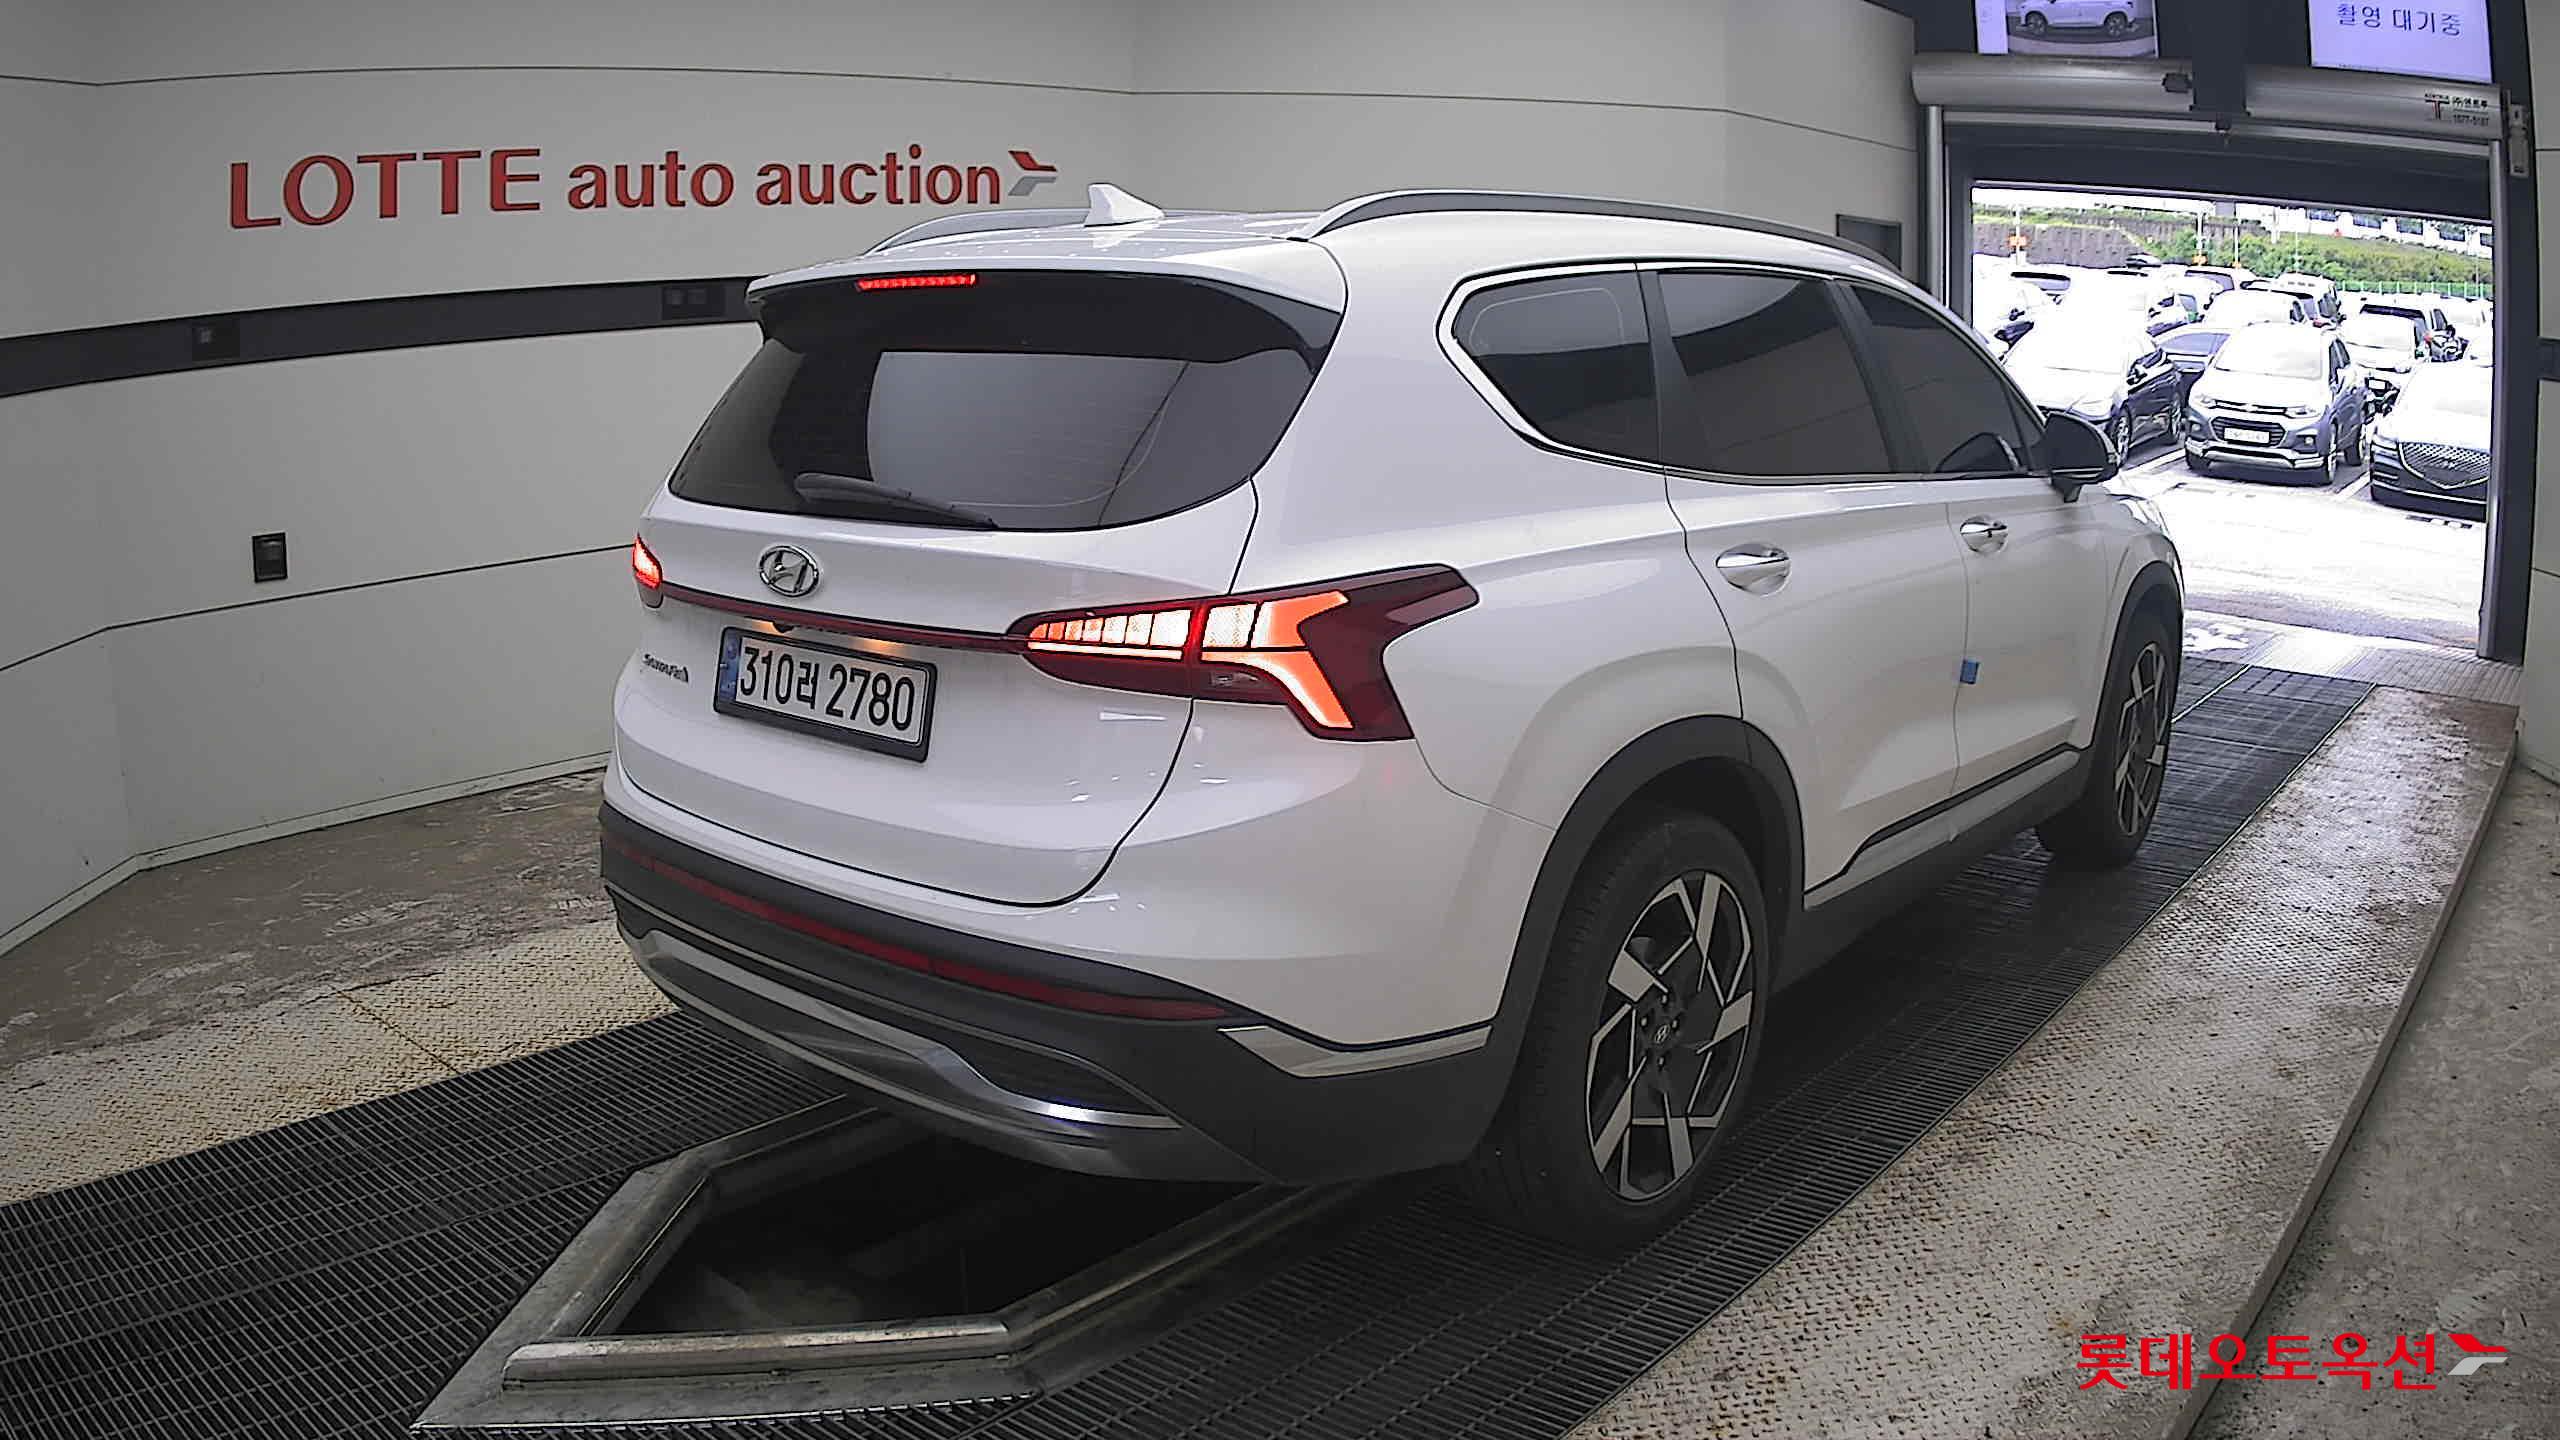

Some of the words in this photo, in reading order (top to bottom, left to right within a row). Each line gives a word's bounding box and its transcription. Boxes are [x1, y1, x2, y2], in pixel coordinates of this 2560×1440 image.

[2337, 3, 2381, 29] 촬영
[2392, 9, 2461, 36] 대기중
[229, 148, 541, 230] LOTTE
[567, 150, 736, 209] auto
[756, 143, 1002, 206] auction
[739, 646, 820, 710] 310러
[825, 663, 916, 731] 2780
